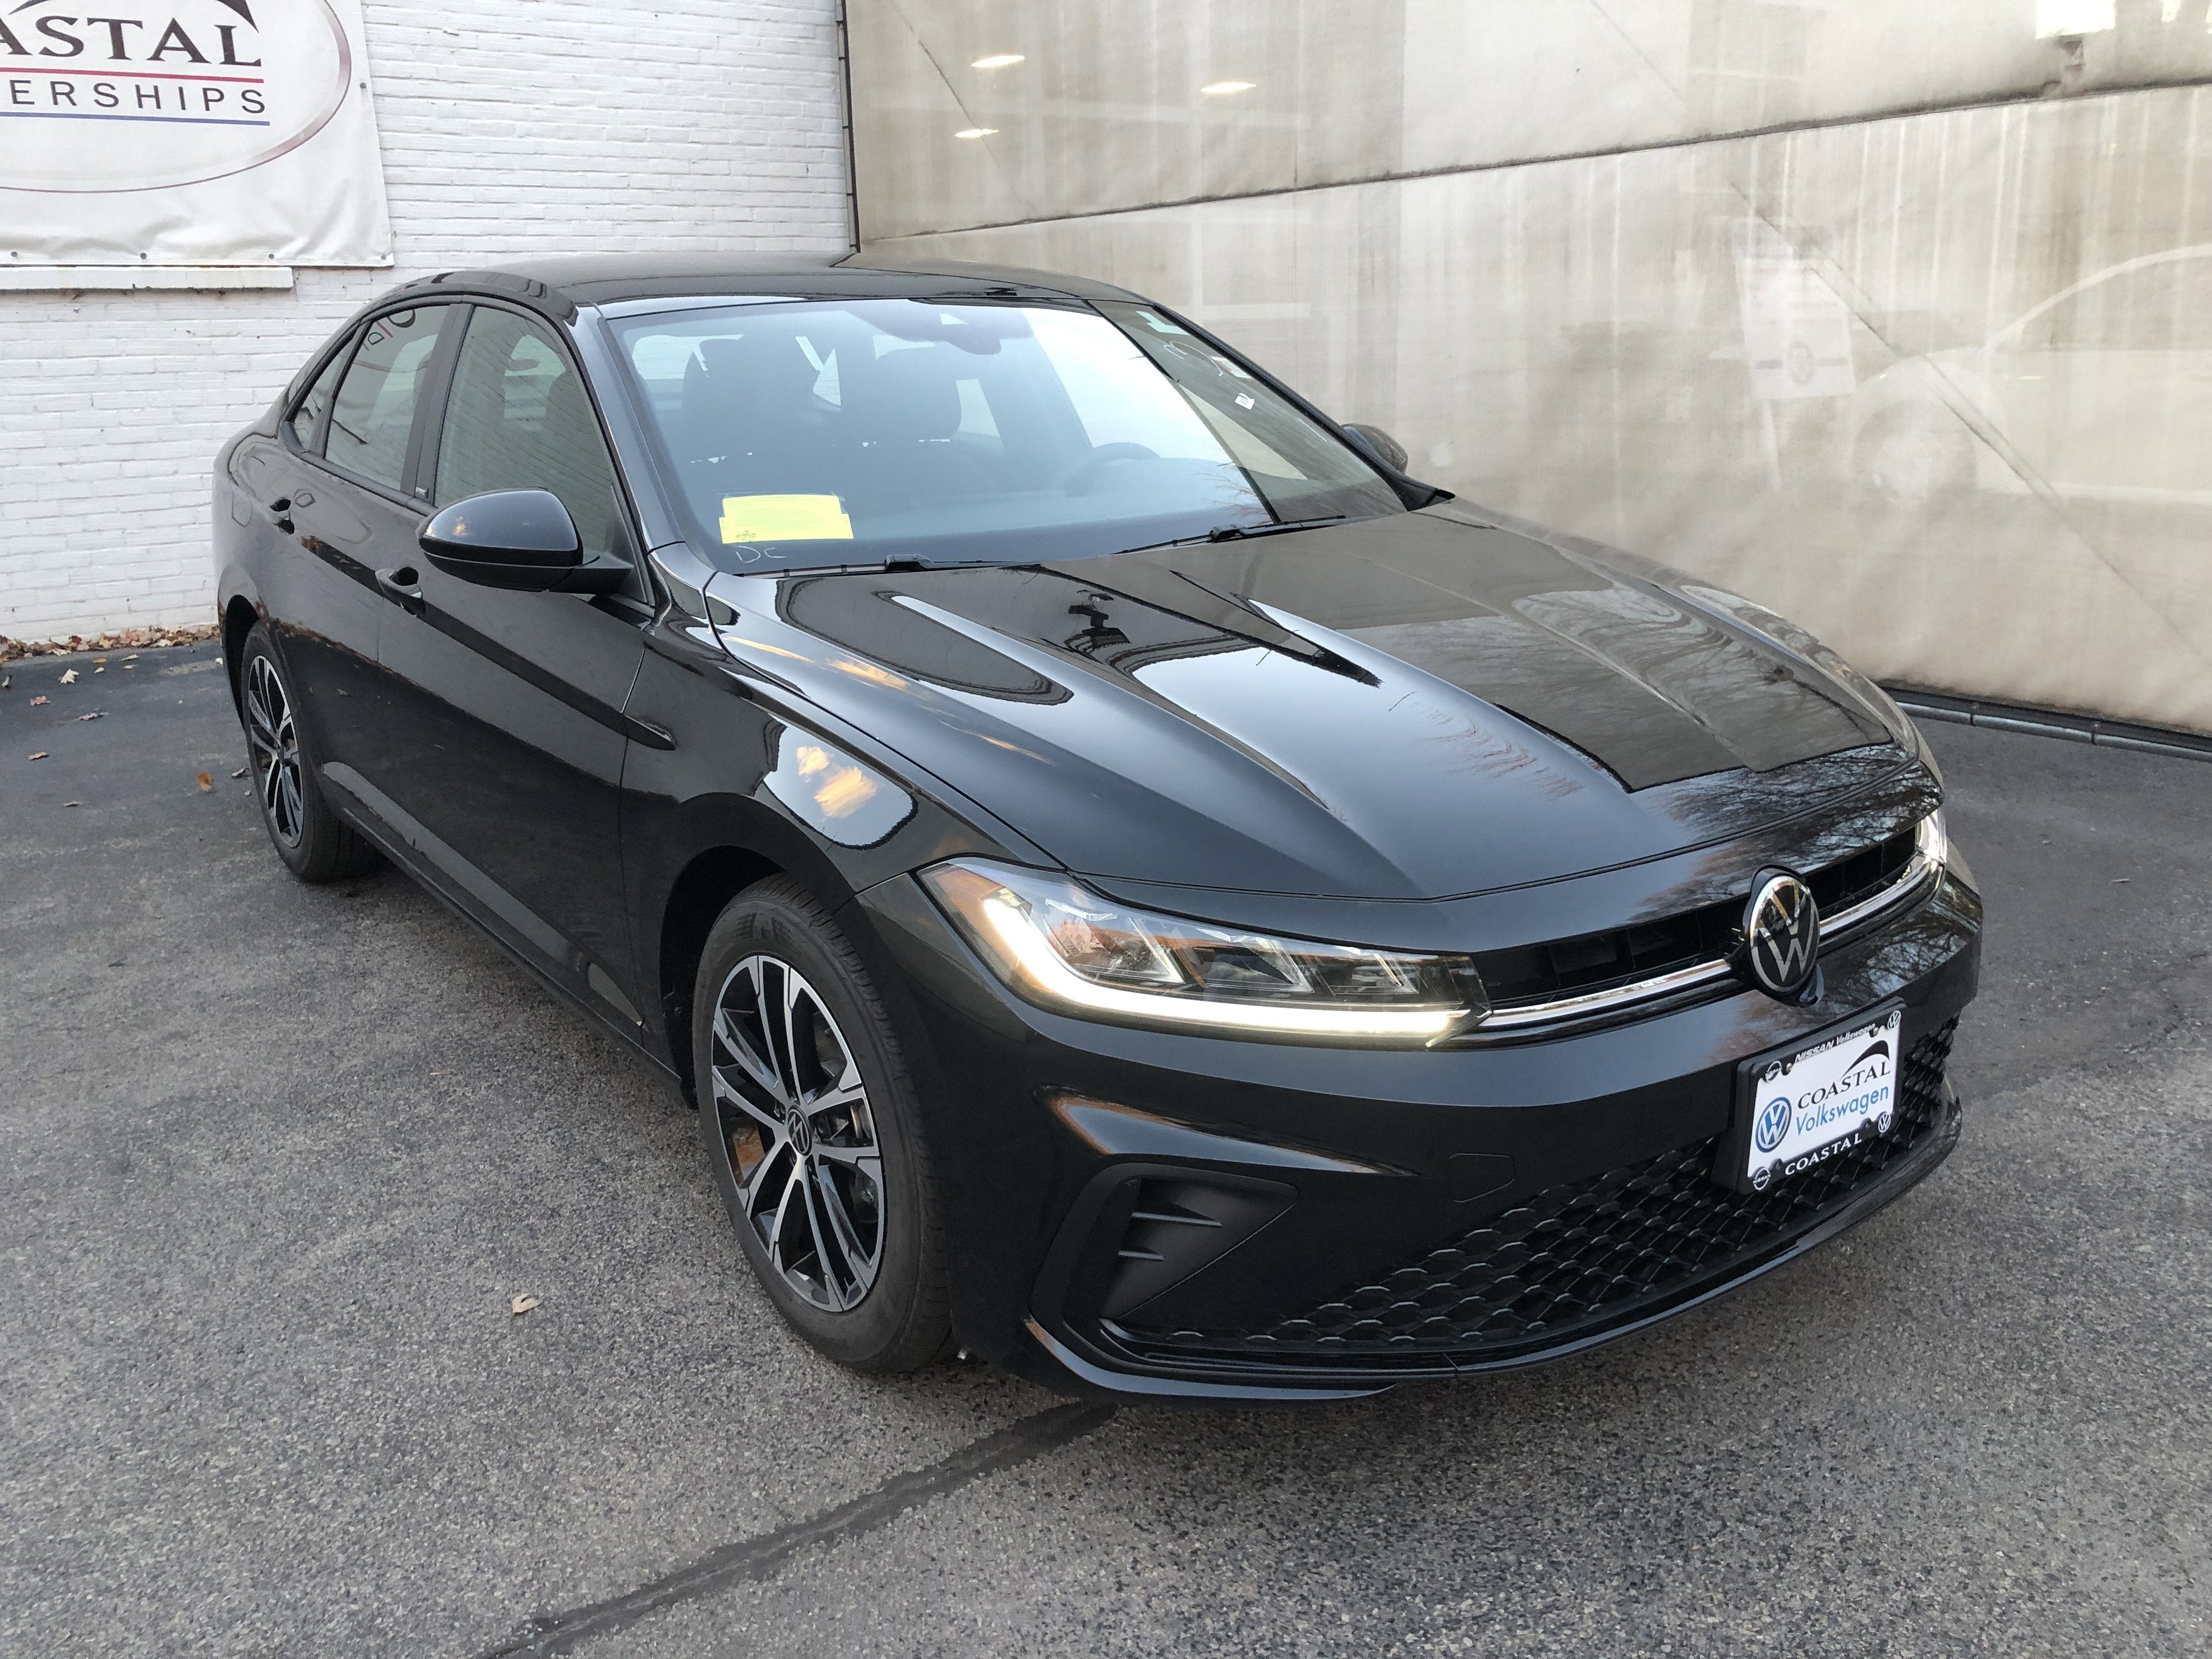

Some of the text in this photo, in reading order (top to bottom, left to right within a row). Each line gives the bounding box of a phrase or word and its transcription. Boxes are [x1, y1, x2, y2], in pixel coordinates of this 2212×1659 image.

[9, 79, 266, 114] ERSHIPS
[1795, 1040, 1834, 1063] NISSAN
[1797, 1062, 1891, 1109] COASTAL
[1796, 1086, 1888, 1136] Volkswagen
[1785, 1133, 1862, 1175] COASTAL
